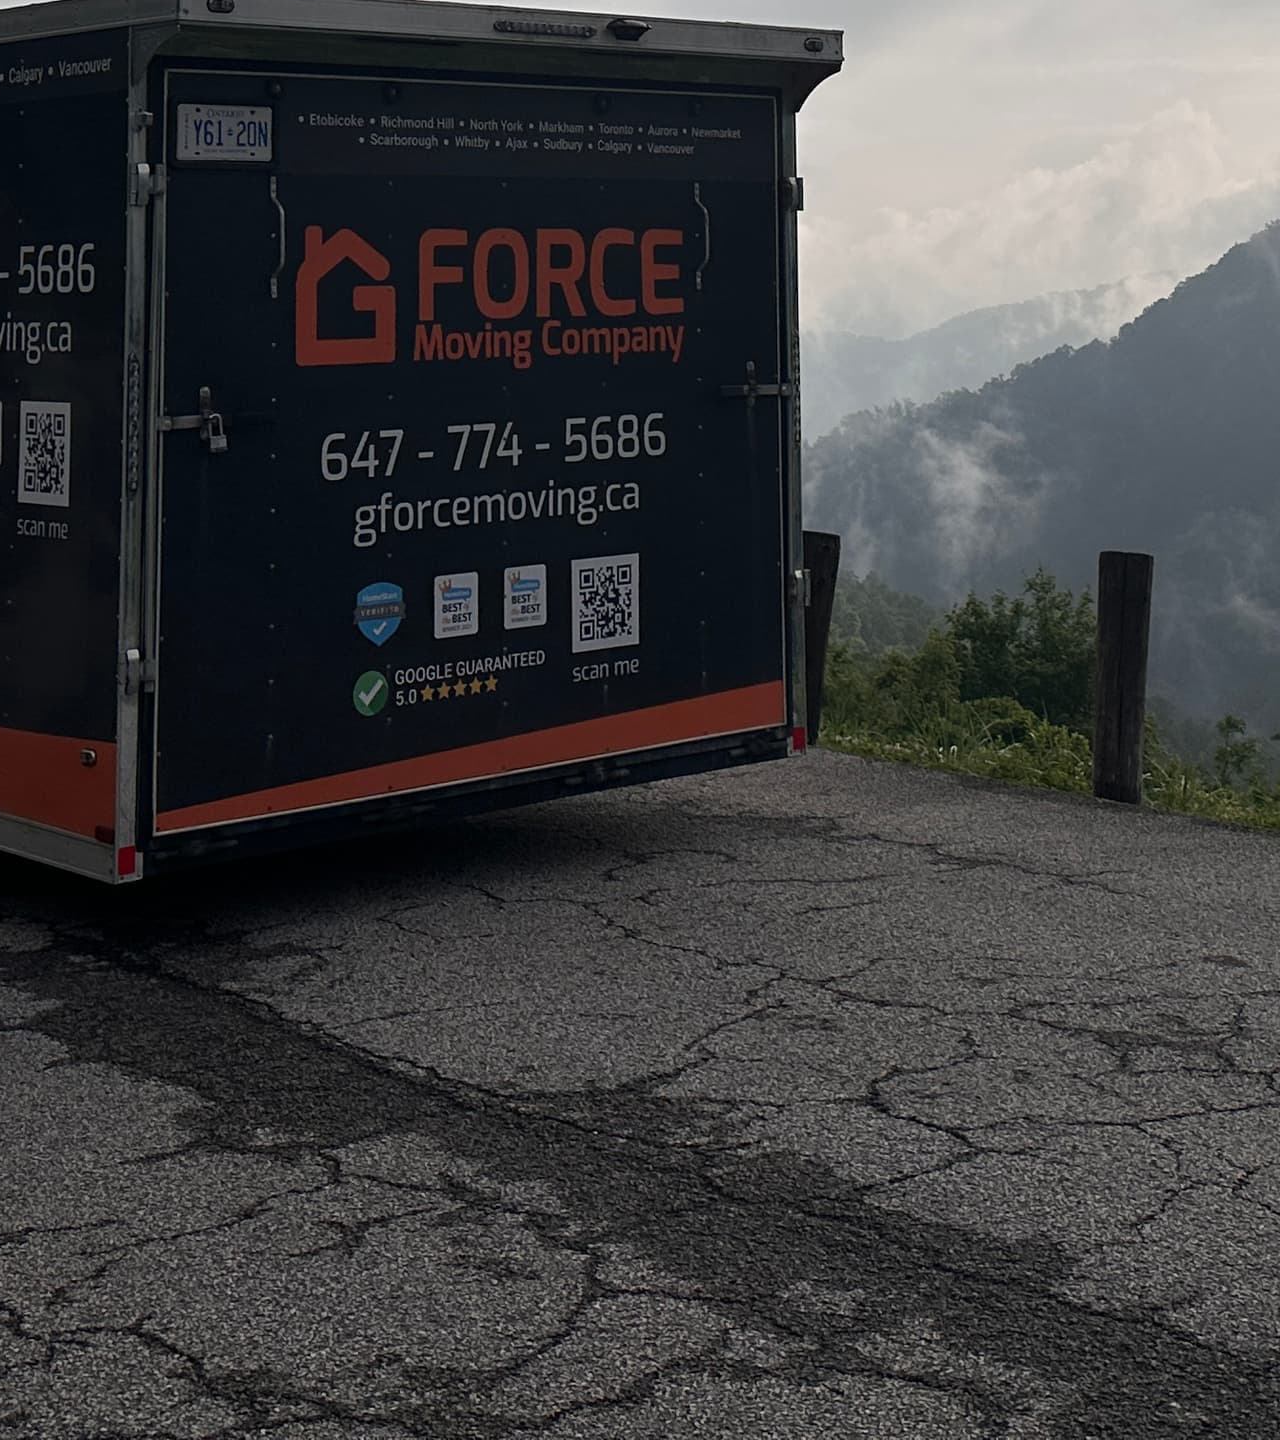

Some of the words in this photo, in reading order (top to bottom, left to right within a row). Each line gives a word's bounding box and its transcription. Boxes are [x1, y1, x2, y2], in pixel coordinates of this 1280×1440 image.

[8, 65, 44, 86] Calgary
[58, 58, 112, 77] Vancouver
[309, 114, 365, 128] Etobicoke
[381, 115, 435, 129] Richmond
[437, 116, 455, 129] Hill
[470, 118, 499, 131] North
[500, 119, 523, 132] York
[539, 121, 584, 134] Markham
[598, 122, 634, 135] Toronto
[647, 125, 678, 137] Aurora
[691, 126, 742, 139] Newmarket
[370, 133, 439, 149] Scarborough
[455, 135, 490, 150] Whitby
[505, 136, 528, 151] Ajax
[543, 138, 583, 153] Sudbury
[597, 140, 633, 154] Calgary
[647, 142, 695, 155] Vancouver
[17, 242, 96, 294] 5686
[418, 226, 685, 321] FORCE
[413, 322, 533, 369] Moving
[541, 320, 685, 366] Company
[320, 427, 405, 481] 647
[447, 421, 523, 471] 774
[563, 412, 667, 462] 5686
[352, 479, 641, 548] gforcemoving.ca
[17, 517, 47, 537] scan
[49, 521, 69, 539] me
[442, 602, 464, 613] BEST
[512, 594, 532, 604] BEST
[521, 603, 541, 614] BEST
[452, 612, 472, 623] BEST
[394, 662, 453, 685] GOOGLE
[455, 649, 546, 678] GUARANTEED
[572, 662, 610, 683] scan
[613, 657, 640, 677] me
[395, 688, 417, 706] 5.0
